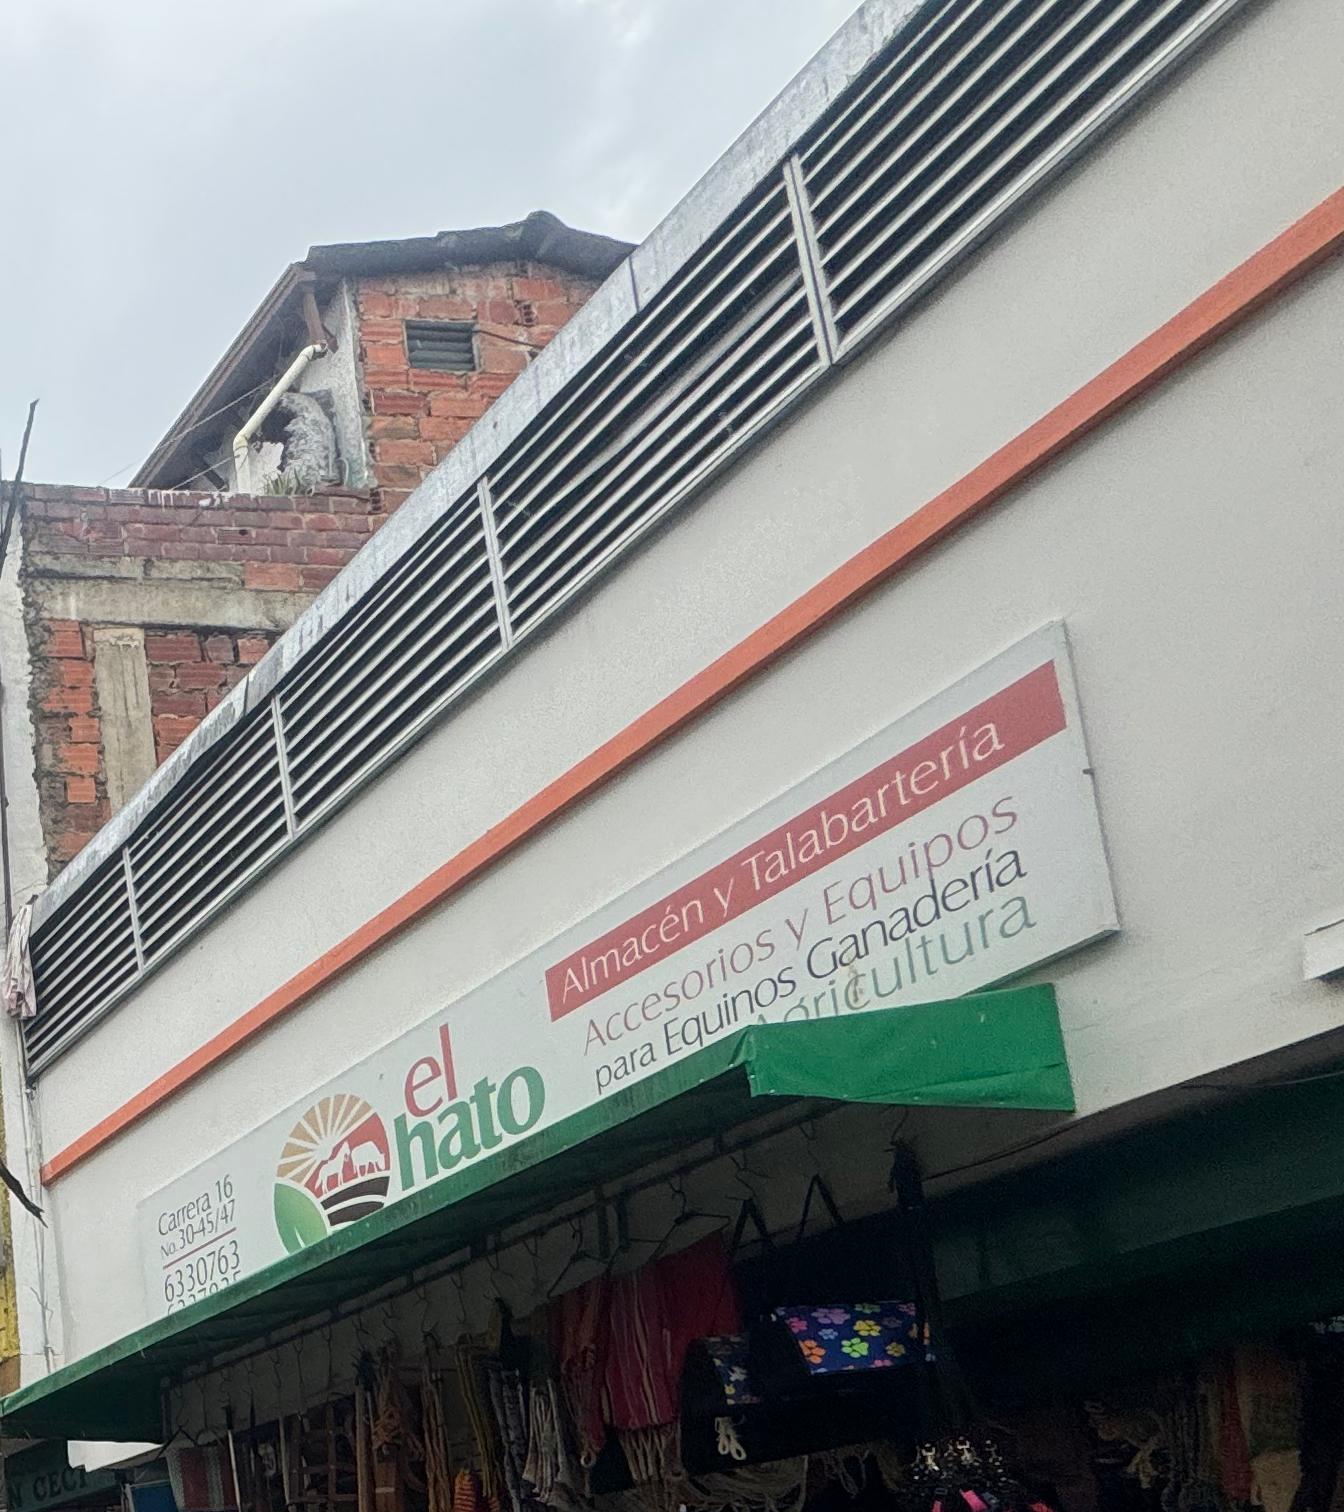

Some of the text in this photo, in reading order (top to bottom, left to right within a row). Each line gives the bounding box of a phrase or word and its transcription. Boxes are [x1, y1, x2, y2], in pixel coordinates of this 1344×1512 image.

[562, 721, 1006, 1005] Almacén y Talabartería
[583, 795, 1019, 1057] Accesorios y Equipos
[595, 848, 1028, 1095] para Equinos Ganadería
[393, 1066, 546, 1191] hato
[404, 1023, 458, 1117] el
[158, 1174, 233, 1236] Carrera 16
[164, 1240, 240, 1302] 6330763
